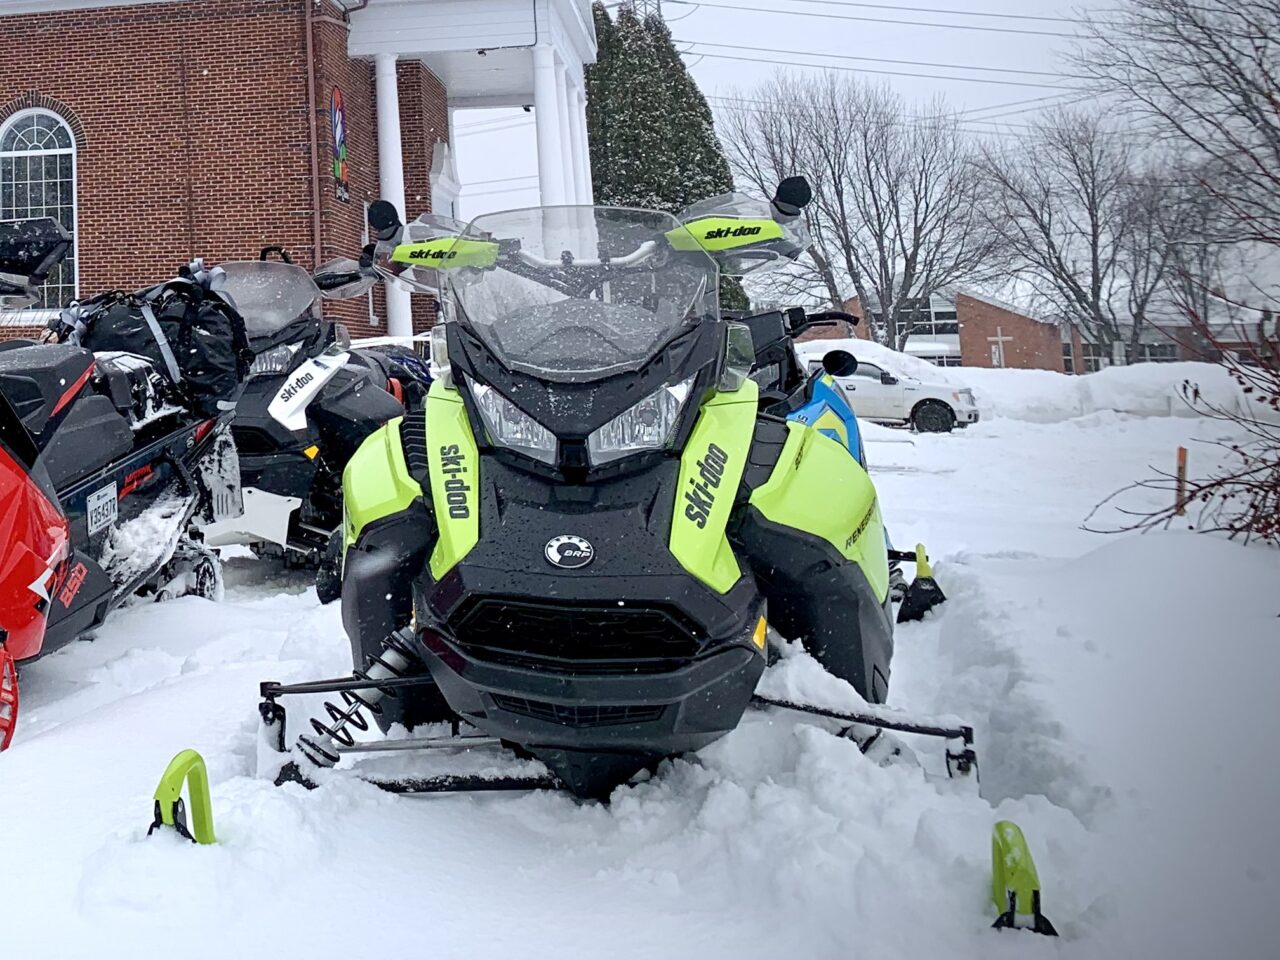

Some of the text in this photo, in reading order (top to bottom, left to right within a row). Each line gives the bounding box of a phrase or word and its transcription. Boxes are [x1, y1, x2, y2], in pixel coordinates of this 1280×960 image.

[704, 225, 762, 240] ski-doo
[280, 372, 314, 403] ski-doo
[440, 444, 471, 519] ski-doo
[684, 442, 729, 530] ski-doo
[563, 549, 591, 558] BRP
